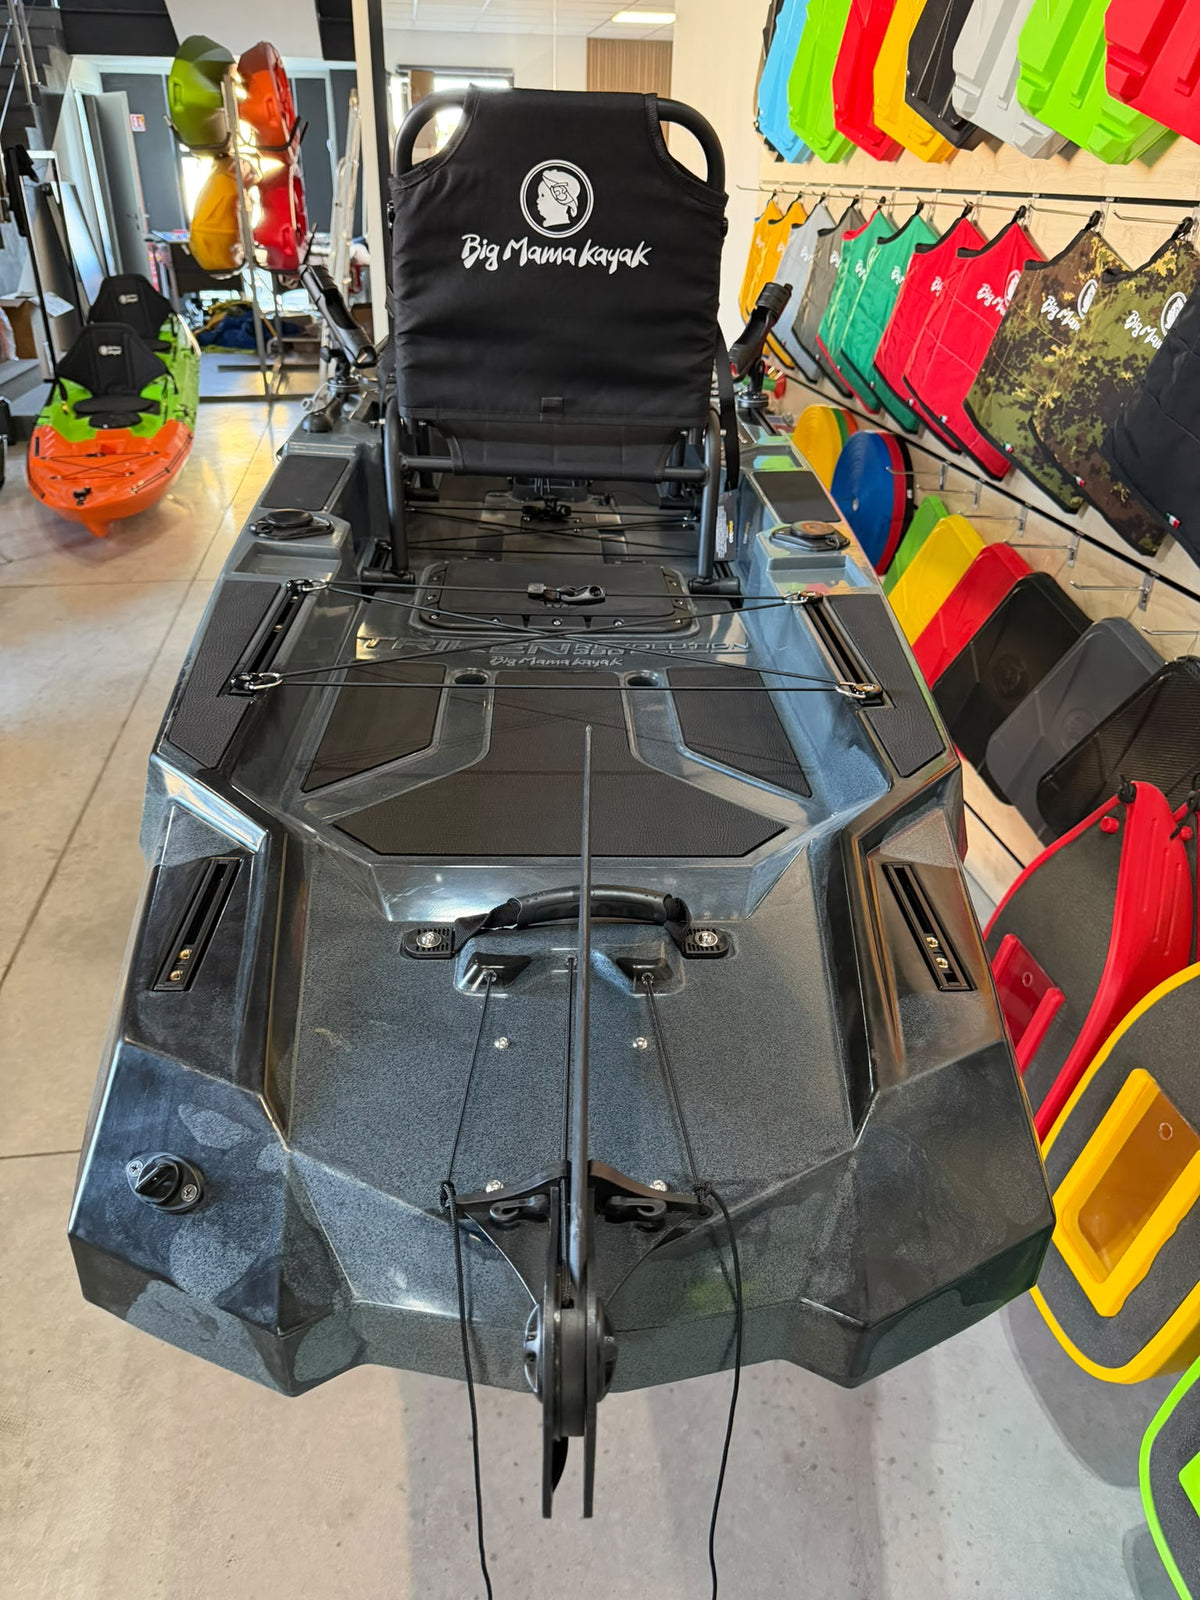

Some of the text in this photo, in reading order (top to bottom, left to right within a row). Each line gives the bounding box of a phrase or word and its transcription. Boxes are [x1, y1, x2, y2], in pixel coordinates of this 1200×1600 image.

[461, 233, 501, 272] Big
[502, 236, 576, 268] Mama
[1040, 295, 1060, 321] Big
[1124, 309, 1143, 338] Big
[489, 655, 518, 667] Big
[518, 656, 570, 666] Mama
